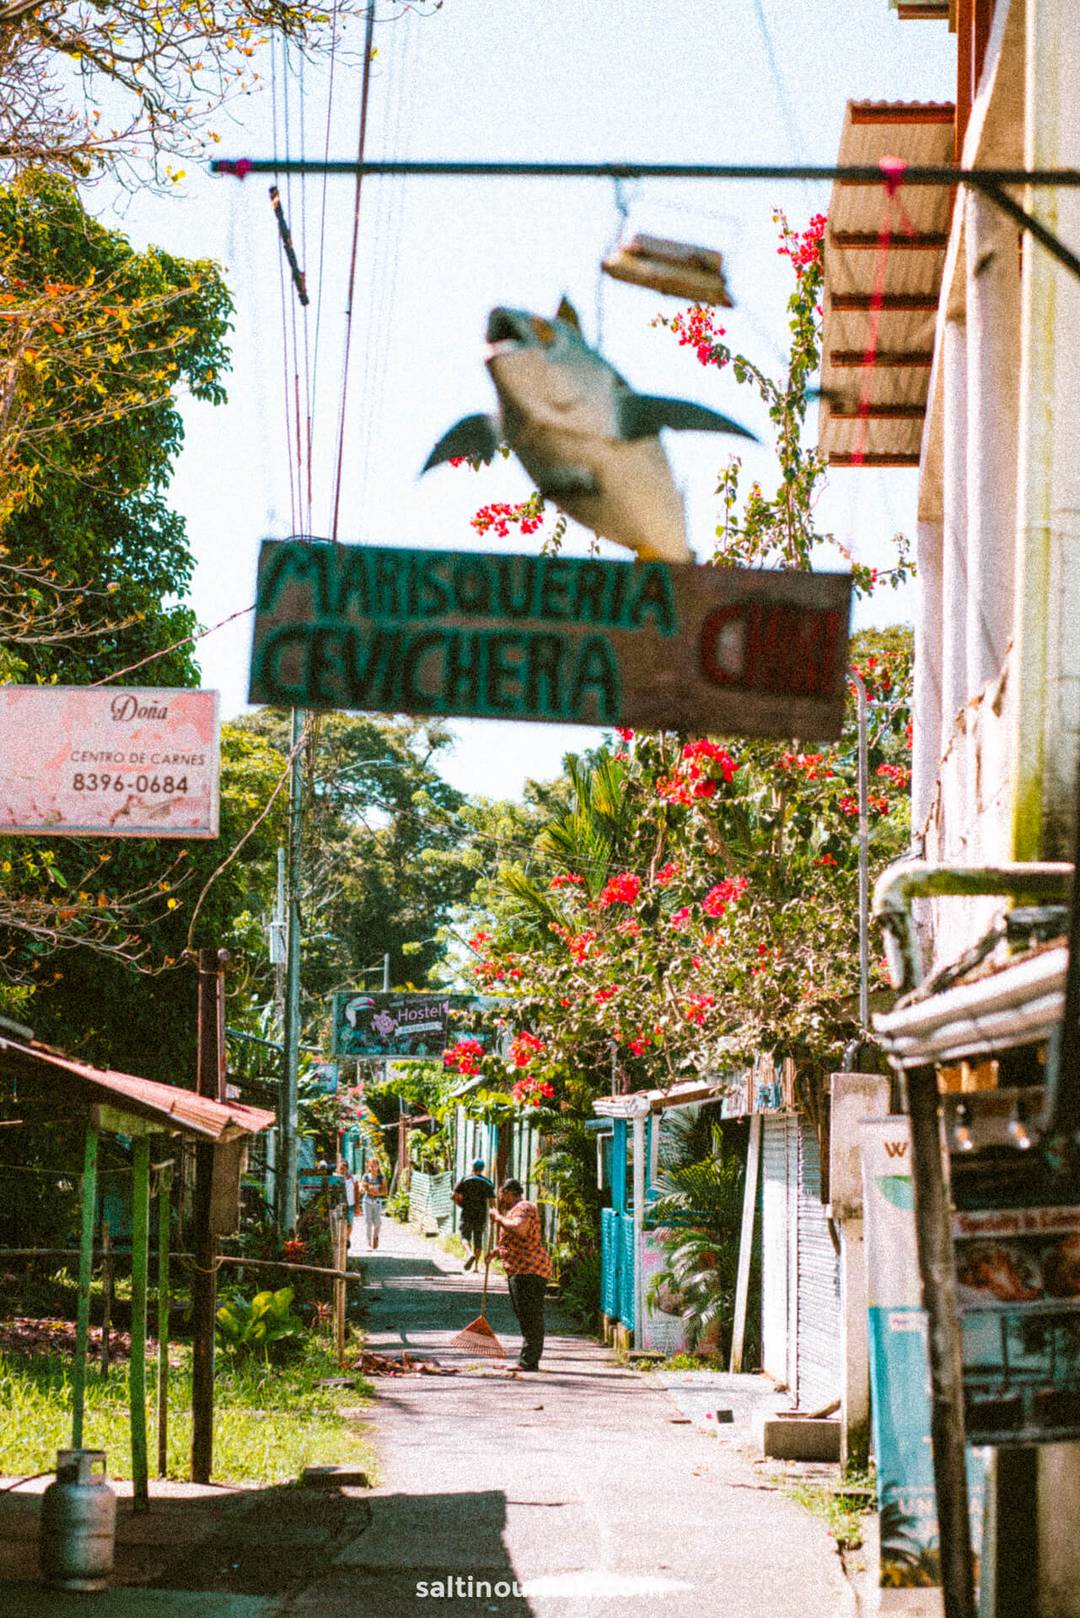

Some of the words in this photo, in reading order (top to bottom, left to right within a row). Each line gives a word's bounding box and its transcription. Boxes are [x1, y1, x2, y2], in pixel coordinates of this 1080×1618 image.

[260, 541, 679, 639] MARISQUERIA
[253, 624, 622, 724] CEVICHERA
[110, 693, 168, 722] Doña
[70, 750, 125, 764] CENTRO
[129, 752, 146, 765] DE
[151, 753, 205, 766] CARNES
[72, 773, 189, 794] 8396-0684
[397, 1003, 442, 1022] Hostel
